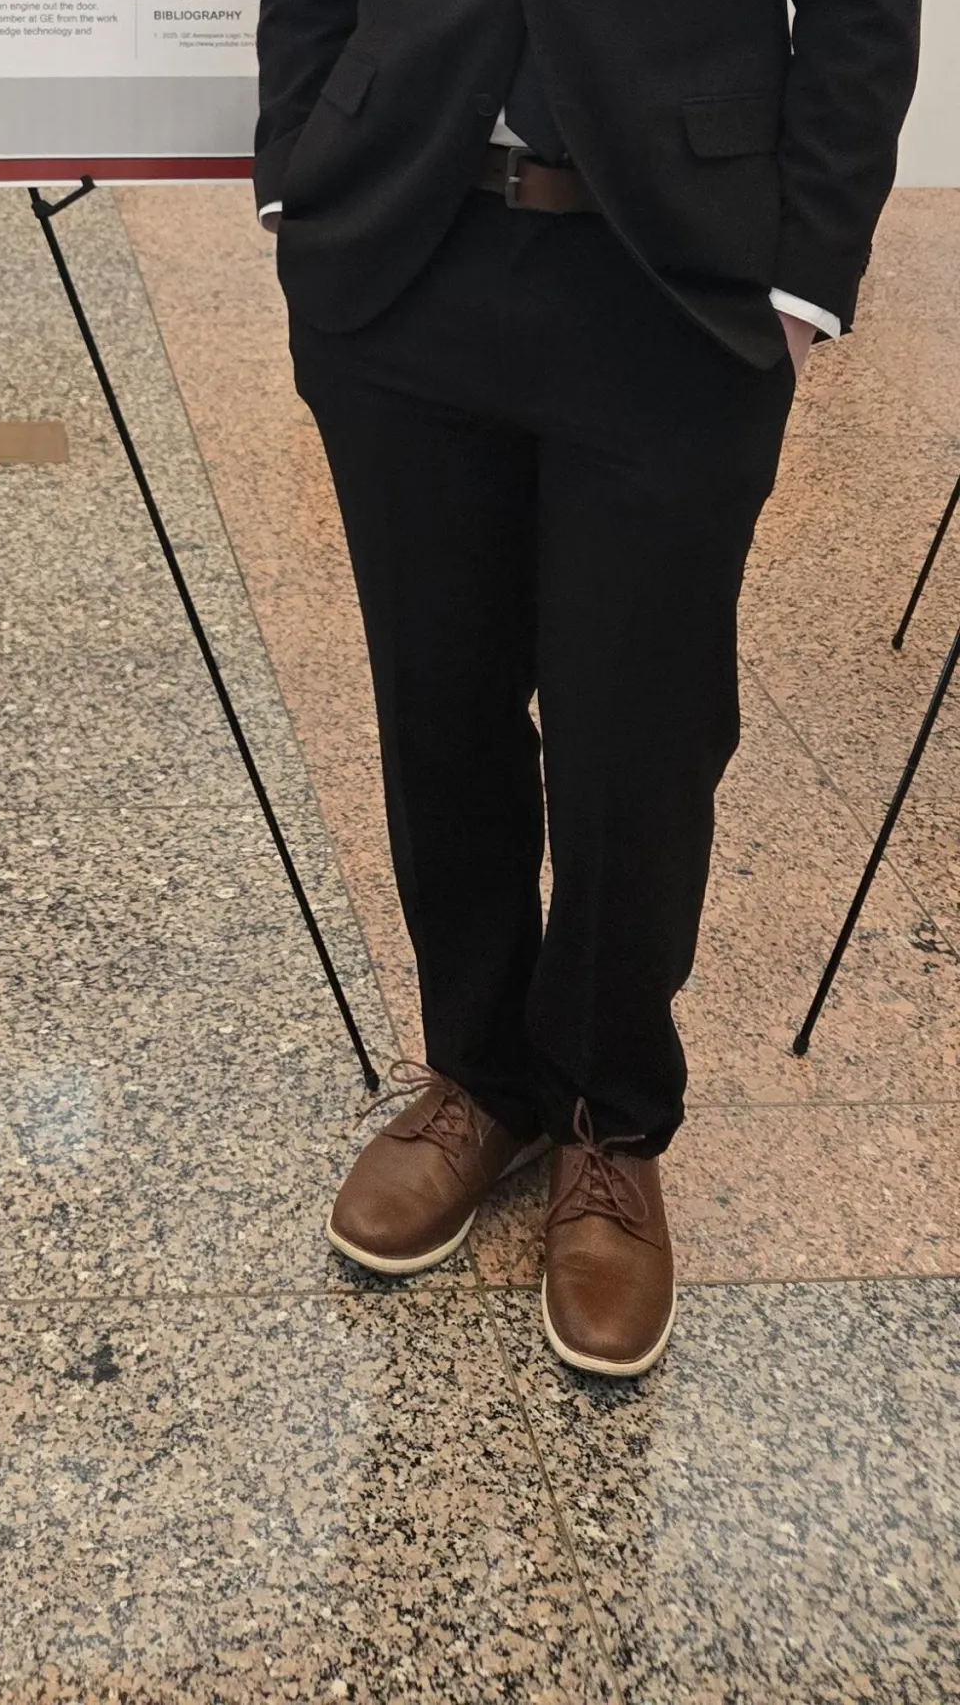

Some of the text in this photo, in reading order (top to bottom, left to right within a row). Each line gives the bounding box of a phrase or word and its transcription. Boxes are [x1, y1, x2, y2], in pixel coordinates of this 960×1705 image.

[9, 1, 40, 13] engine
[42, 2, 57, 10] out
[59, 1, 74, 10] the
[75, 1, 98, 10] door.
[153, 10, 242, 20] BIBLIOGRAPHY
